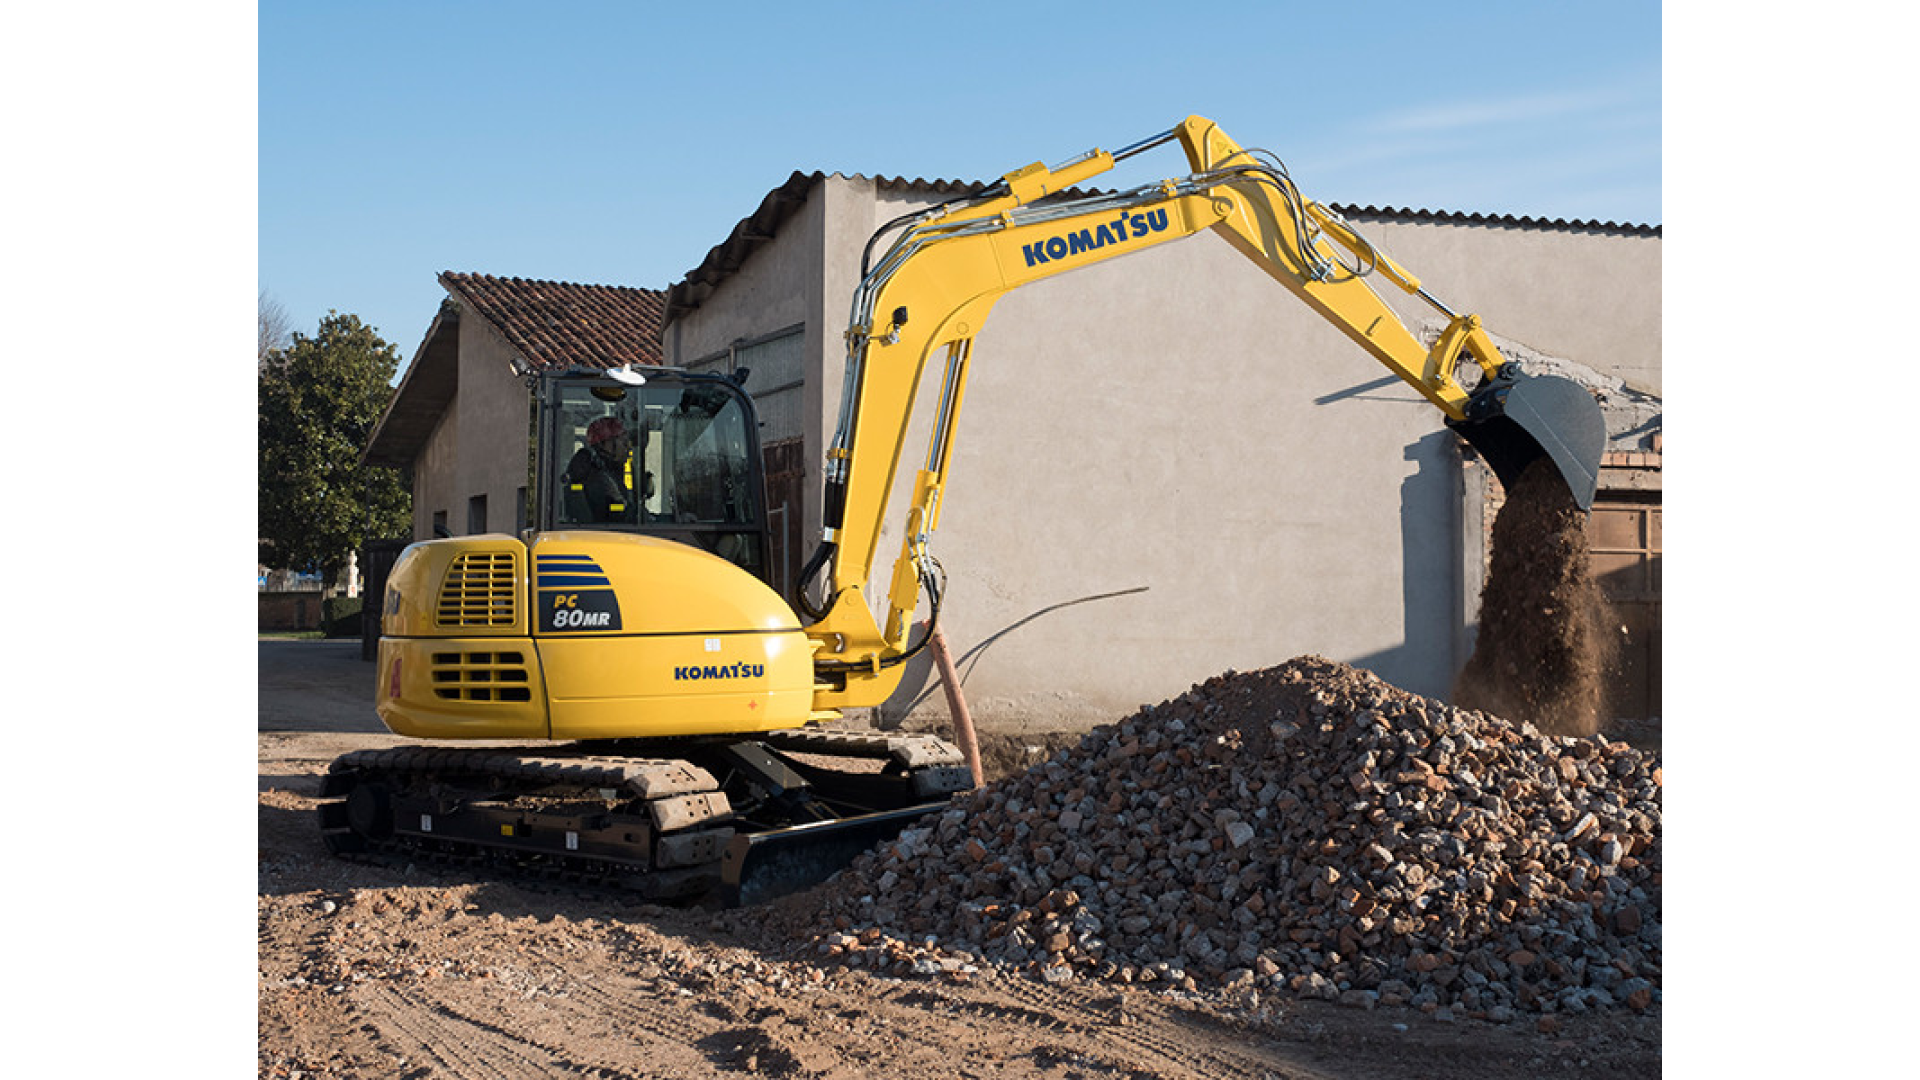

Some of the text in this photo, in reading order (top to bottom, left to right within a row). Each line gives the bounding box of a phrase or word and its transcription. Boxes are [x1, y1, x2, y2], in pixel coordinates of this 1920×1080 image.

[1022, 208, 1169, 267] KOMATSU
[554, 594, 578, 608] PC
[553, 609, 611, 628] 80MR
[674, 661, 764, 680] KOMATSU
